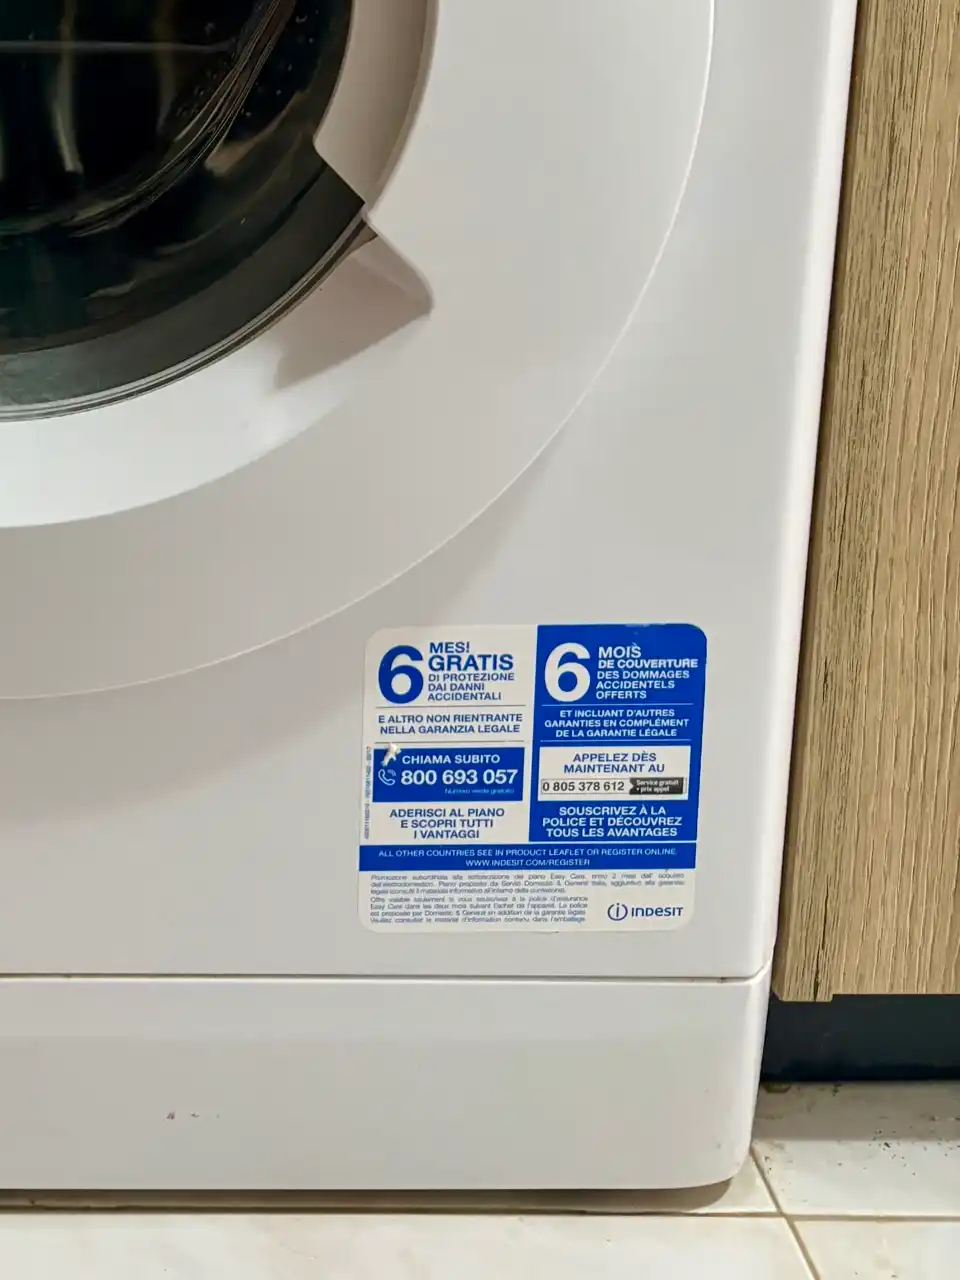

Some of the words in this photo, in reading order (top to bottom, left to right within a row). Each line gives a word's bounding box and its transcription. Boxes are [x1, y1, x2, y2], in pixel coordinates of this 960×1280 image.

[430, 641, 470, 654] MES!
[598, 646, 641, 658] MOIS
[428, 654, 513, 671] GRATIS
[598, 659, 615, 669] DE
[617, 658, 698, 669] COUVERTURE
[378, 645, 424, 704] 6
[428, 674, 440, 682] DI
[443, 672, 514, 682] PROTEZIONE
[545, 642, 591, 702] 6
[597, 670, 620, 679] DES
[622, 670, 690, 679] DOMMAGES
[428, 683, 447, 692] DAI
[450, 683, 485, 691] DANNI
[596, 680, 675, 689] ACCIDENTELS
[427, 692, 501, 701] ACCIDENTALI
[596, 690, 647, 699] OFFERTS
[378, 715, 385, 724] E
[388, 715, 424, 723] ALTRO
[426, 714, 450, 723] NON
[453, 713, 523, 723] RIENTRANTE
[560, 710, 572, 718] ET
[574, 709, 624, 717] INCLUANT
[626, 709, 675, 717] D'AUTRES
[544, 719, 601, 728] GARANTIES
[603, 719, 617, 727] EN
[619, 717, 689, 727] COMPLÉMENT
[380, 726, 416, 734] NELLA
[418, 725, 475, 734] GARANZIA
[478, 724, 520, 733] LEGALE
[586, 729, 636, 737] GARANTIE
[639, 728, 677, 737] LÉGALE
[402, 755, 451, 764] CHIAMA
[455, 754, 500, 764] SUBITO
[573, 753, 628, 762] APPELEZ
[632, 751, 657, 762] DÈS
[564, 764, 645, 773] MAINTENANT
[648, 764, 665, 772] AU
[401, 770, 437, 785] 800
[442, 769, 478, 785] 693
[483, 769, 518, 784] 057
[542, 782, 550, 792] 0
[553, 781, 575, 791] 805
[578, 782, 600, 791] 378
[603, 781, 624, 791] 612
[389, 808, 446, 818] ADERISCI
[449, 808, 464, 817] AL
[468, 808, 505, 817] PIANO
[559, 806, 637, 816] SOUSCRIVEZ
[639, 804, 648, 815] À
[651, 806, 666, 815] LA
[401, 819, 408, 828] E
[411, 819, 456, 828] SCOPRI
[460, 819, 493, 828] TUTTI
[542, 817, 586, 827] POLICE
[589, 817, 604, 826] ET
[608, 815, 682, 826] DÉCOUVREZ
[414, 830, 417, 839] I
[420, 829, 479, 839] VANTAGGI
[546, 828, 579, 837] TOUS
[582, 828, 604, 837] LES
[607, 827, 677, 837] AVANTAGES
[586, 848, 599, 856] OR
[601, 848, 643, 856] REGISTER
[631, 907, 683, 917] INDESIT
